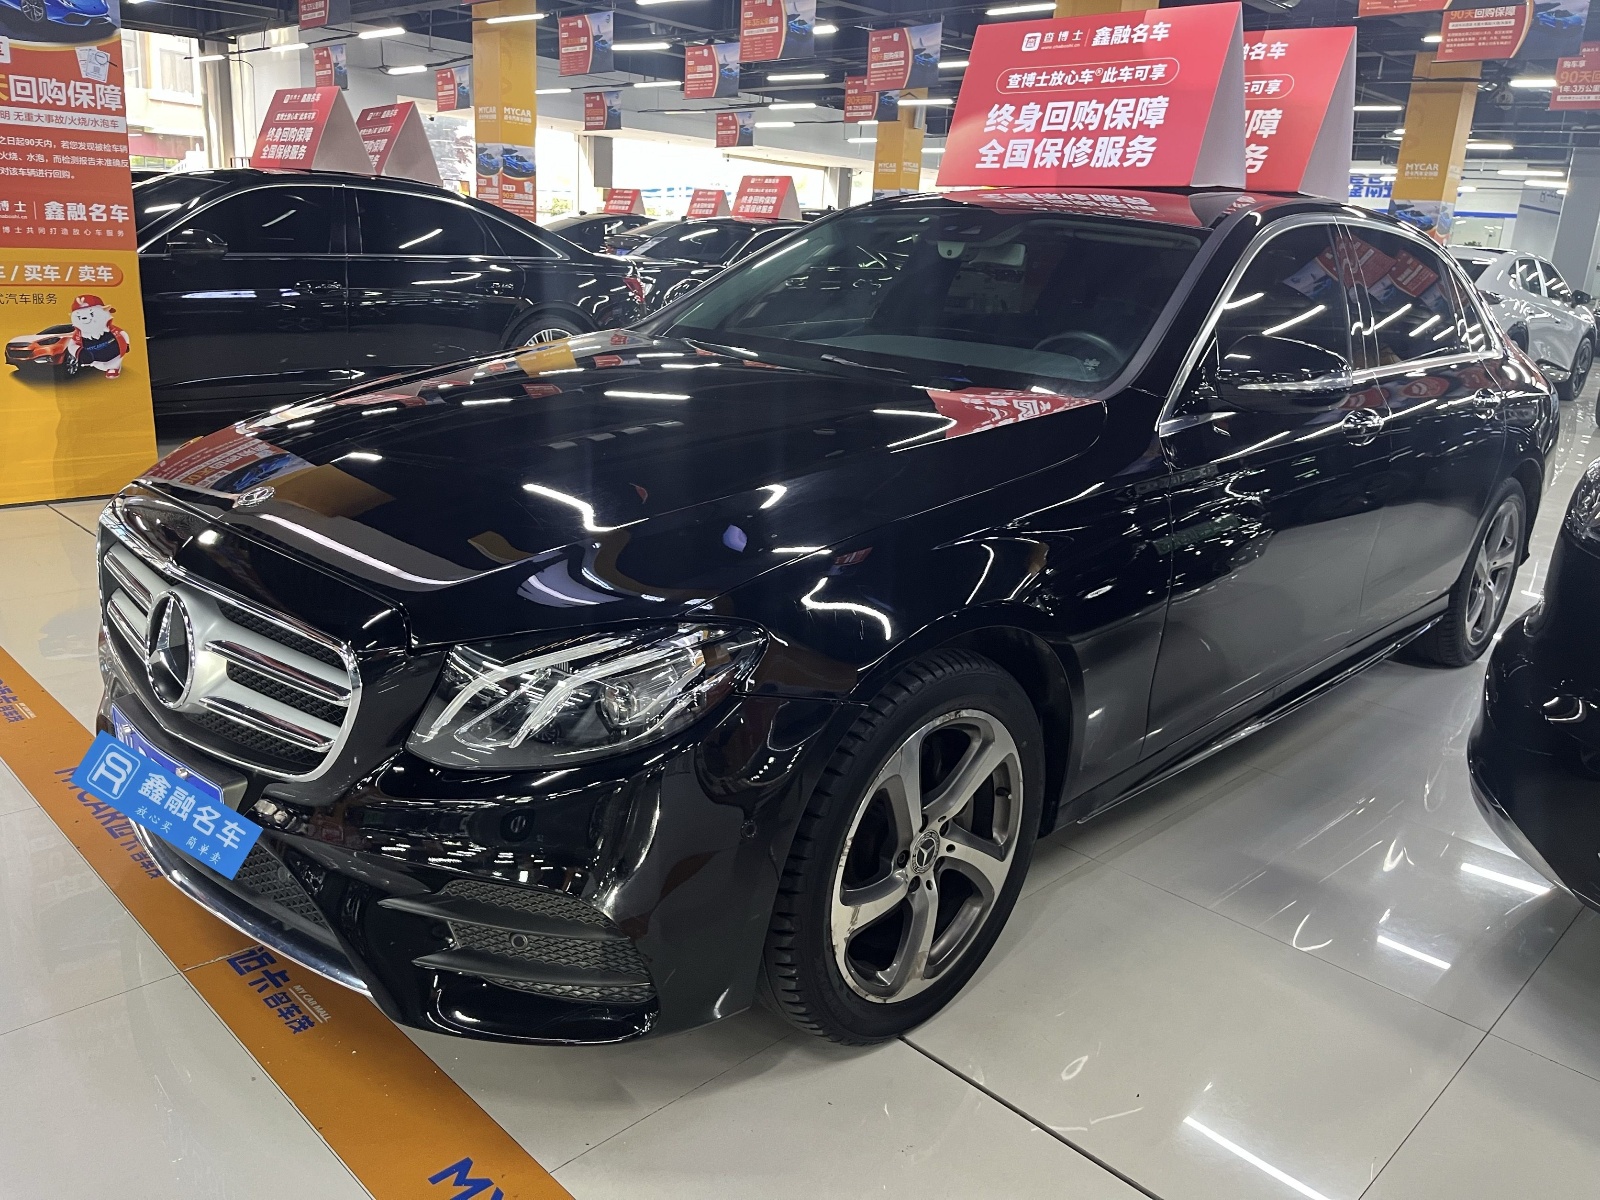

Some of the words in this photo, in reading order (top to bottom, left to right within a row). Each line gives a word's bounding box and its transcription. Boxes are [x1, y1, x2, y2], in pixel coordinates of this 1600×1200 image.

[1091, 22, 1172, 47] 鑫融名车
[503, 106, 532, 118] MYCAR
[983, 95, 1170, 133] 终身回购保障
[1245, 108, 1283, 138] 障
[260, 144, 307, 160] 全国保修服务
[975, 135, 1158, 169] 全国保修服务
[1405, 163, 1439, 171] MYCAR
[44, 201, 130, 223] 鑫融名车
